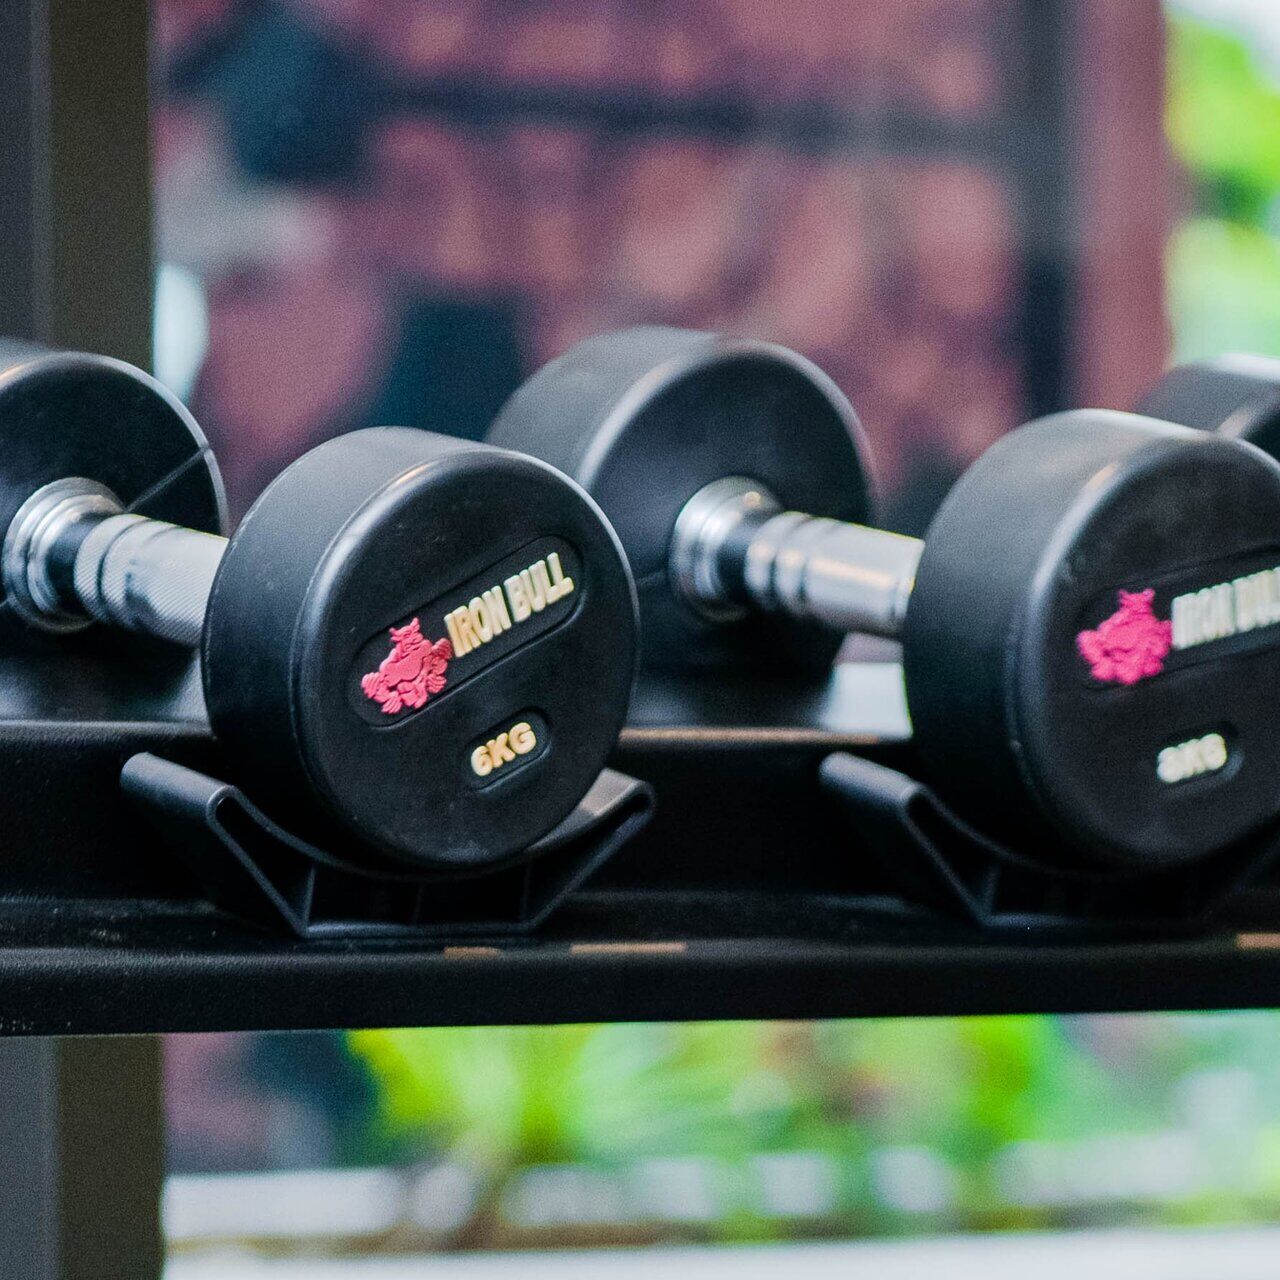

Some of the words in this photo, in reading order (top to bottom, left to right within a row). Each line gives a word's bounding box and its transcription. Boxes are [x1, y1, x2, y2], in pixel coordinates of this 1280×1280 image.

[444, 585, 512, 658] IRON
[504, 552, 575, 622] BULL
[471, 722, 536, 776] 6KG
